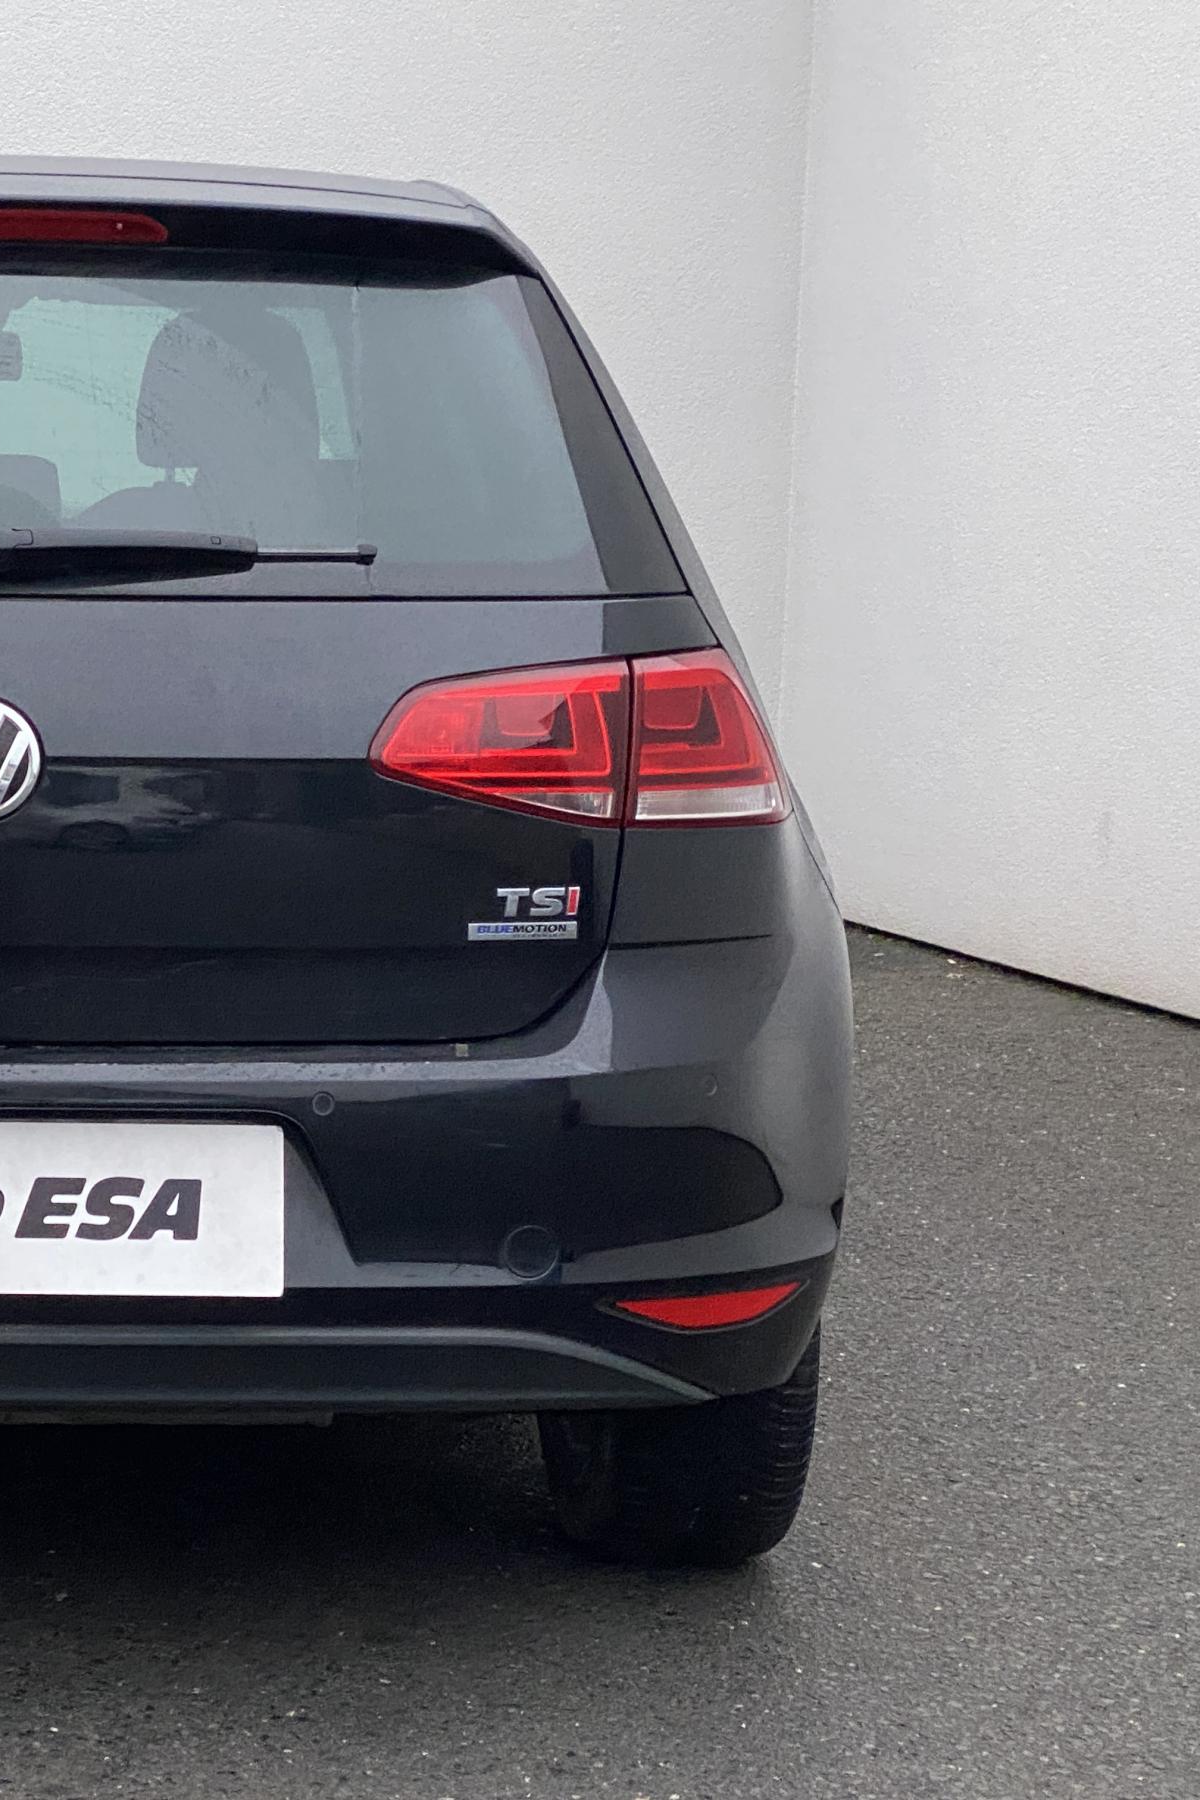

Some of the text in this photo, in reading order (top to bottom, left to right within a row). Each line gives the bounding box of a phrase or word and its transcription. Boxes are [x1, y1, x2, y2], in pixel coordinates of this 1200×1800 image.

[496, 886, 581, 917] TSI
[476, 924, 567, 934] BLUEMOTION
[14, 1176, 203, 1241] ESA
